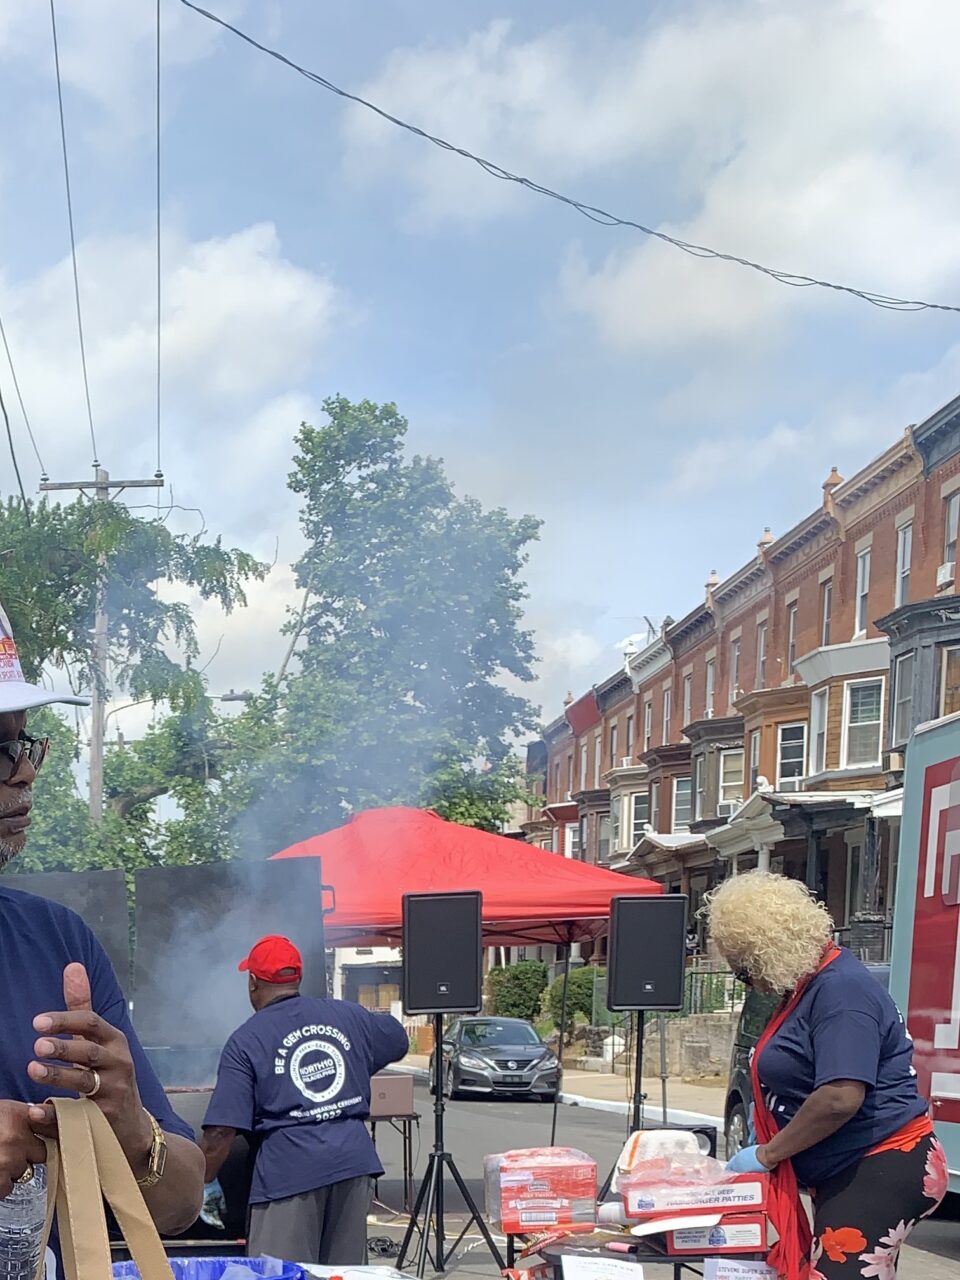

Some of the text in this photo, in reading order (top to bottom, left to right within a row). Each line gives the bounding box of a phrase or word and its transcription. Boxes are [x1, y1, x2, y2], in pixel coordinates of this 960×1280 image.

[275, 1025, 351, 1074] BE A GEM CROSSING
[721, 1194, 755, 1203] PATTIES
